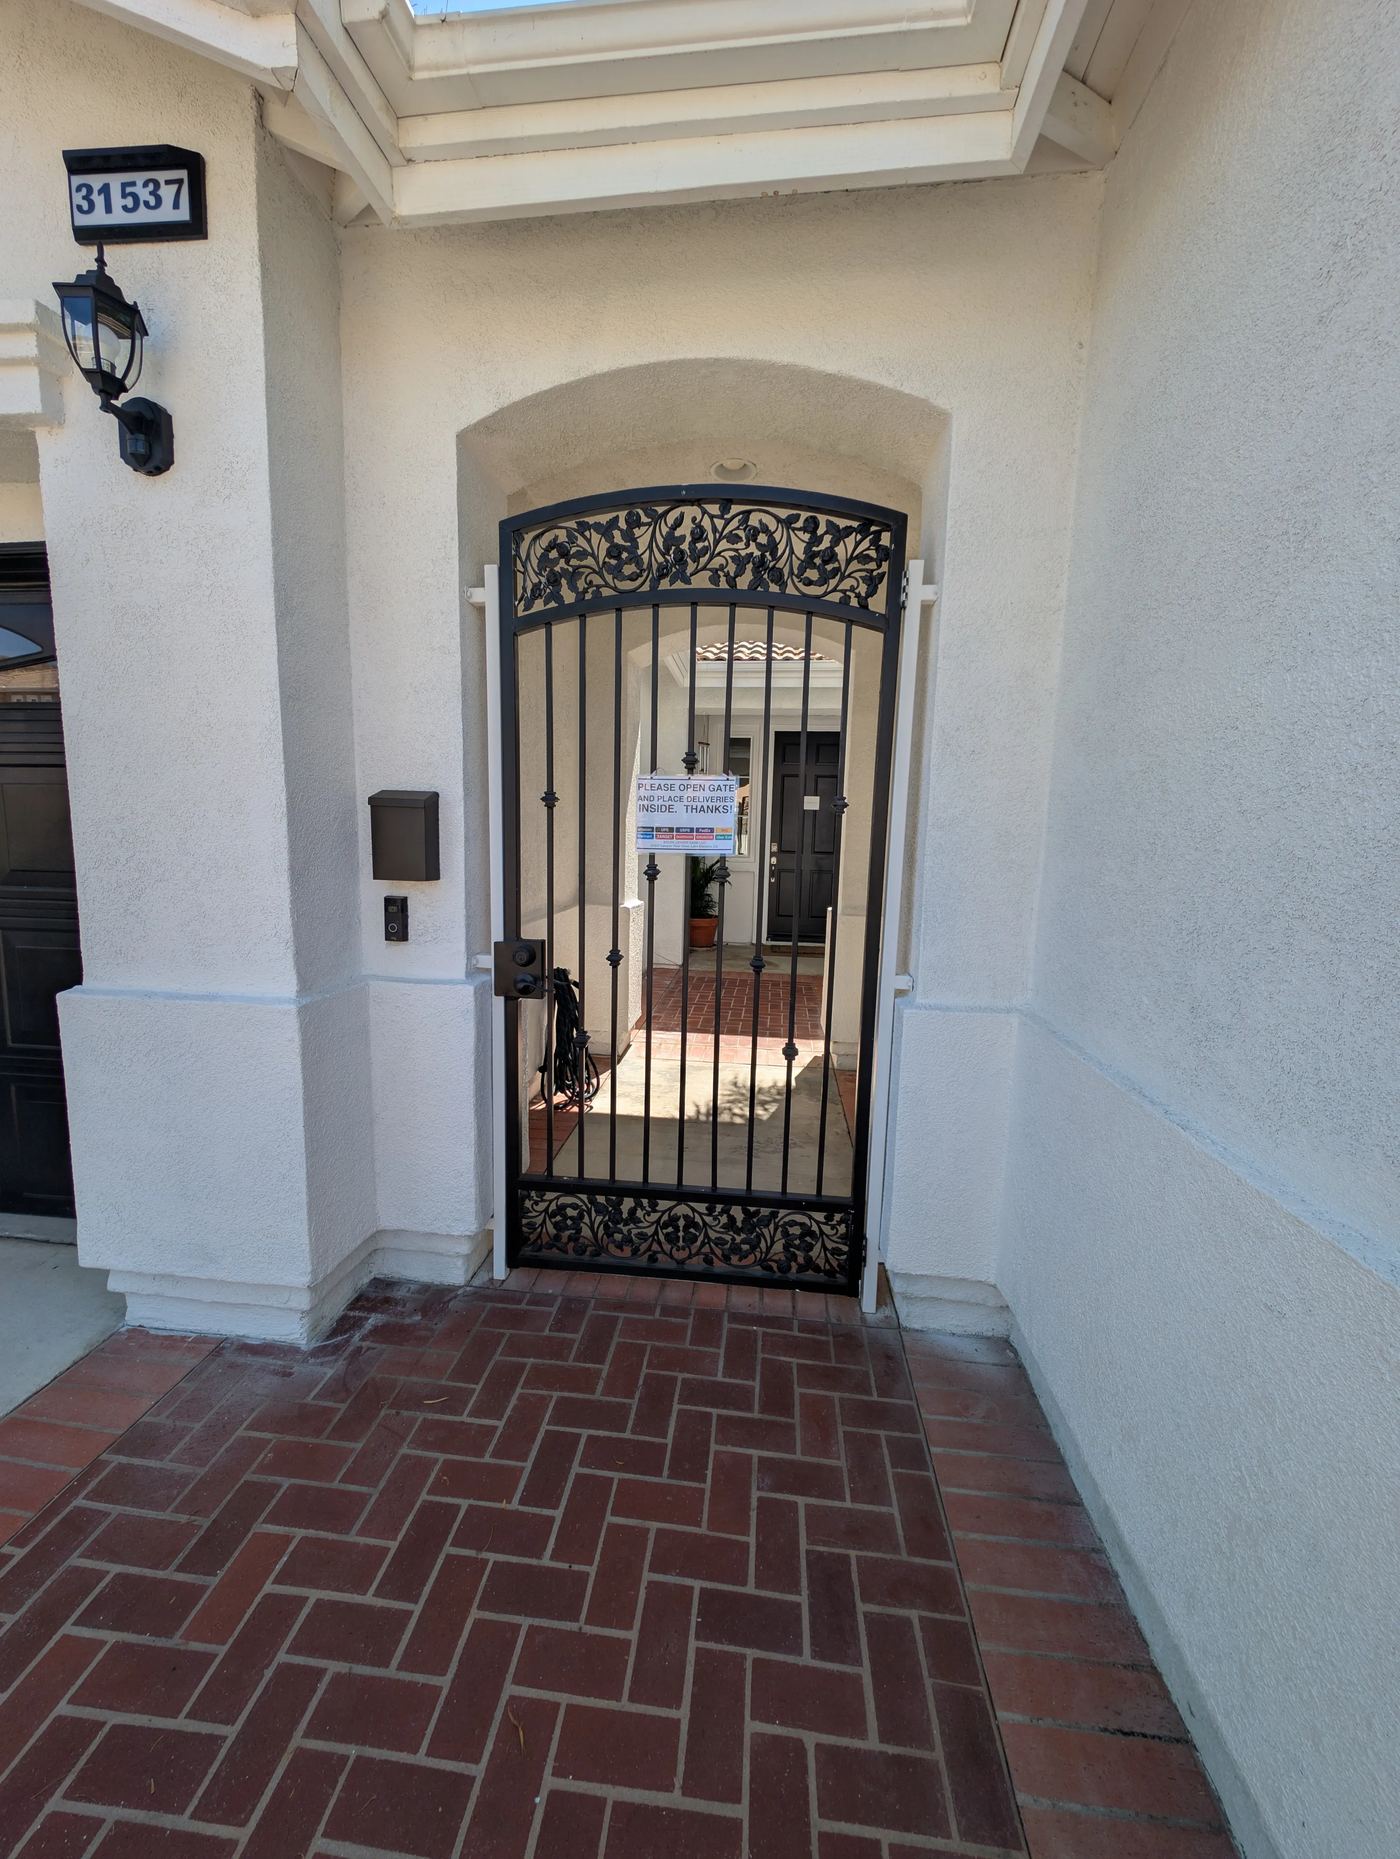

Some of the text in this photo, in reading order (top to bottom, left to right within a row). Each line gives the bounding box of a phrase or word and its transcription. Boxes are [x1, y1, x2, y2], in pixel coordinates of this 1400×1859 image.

[75, 177, 185, 215] 31537
[637, 783, 735, 793] PLEASE OPEN GATE
[637, 794, 735, 804] AND PLACE DELIVERIES
[638, 804, 733, 814] INSIDE. THANKS!
